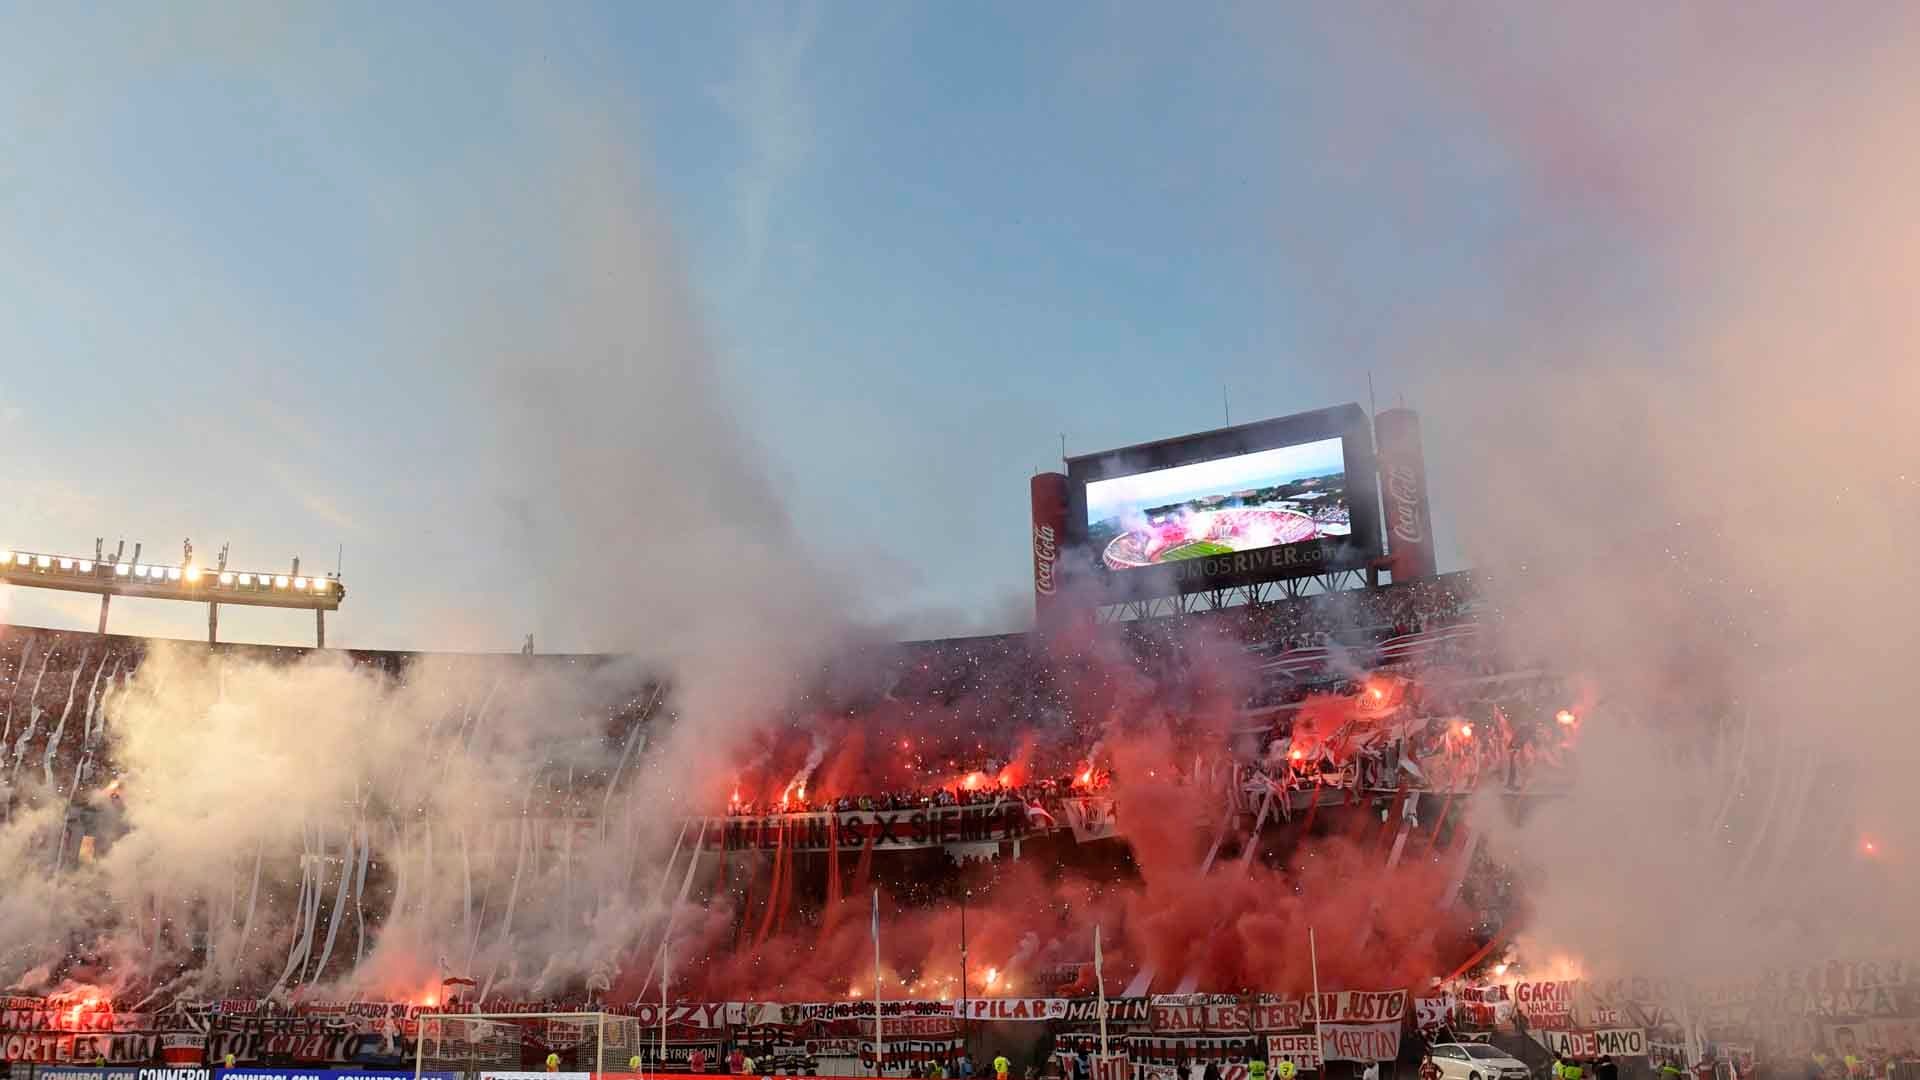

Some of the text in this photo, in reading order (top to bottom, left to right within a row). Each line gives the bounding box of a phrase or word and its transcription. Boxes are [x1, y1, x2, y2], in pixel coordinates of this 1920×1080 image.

[639, 1003, 722, 1027] OZZY
[974, 1000, 1046, 1018] PILAR
[1343, 990, 1403, 1018] JUSTO
[1156, 1004, 1301, 1029] BALLESTER
[1571, 1031, 1595, 1053] DE
[1596, 1029, 1641, 1053] MAYO
